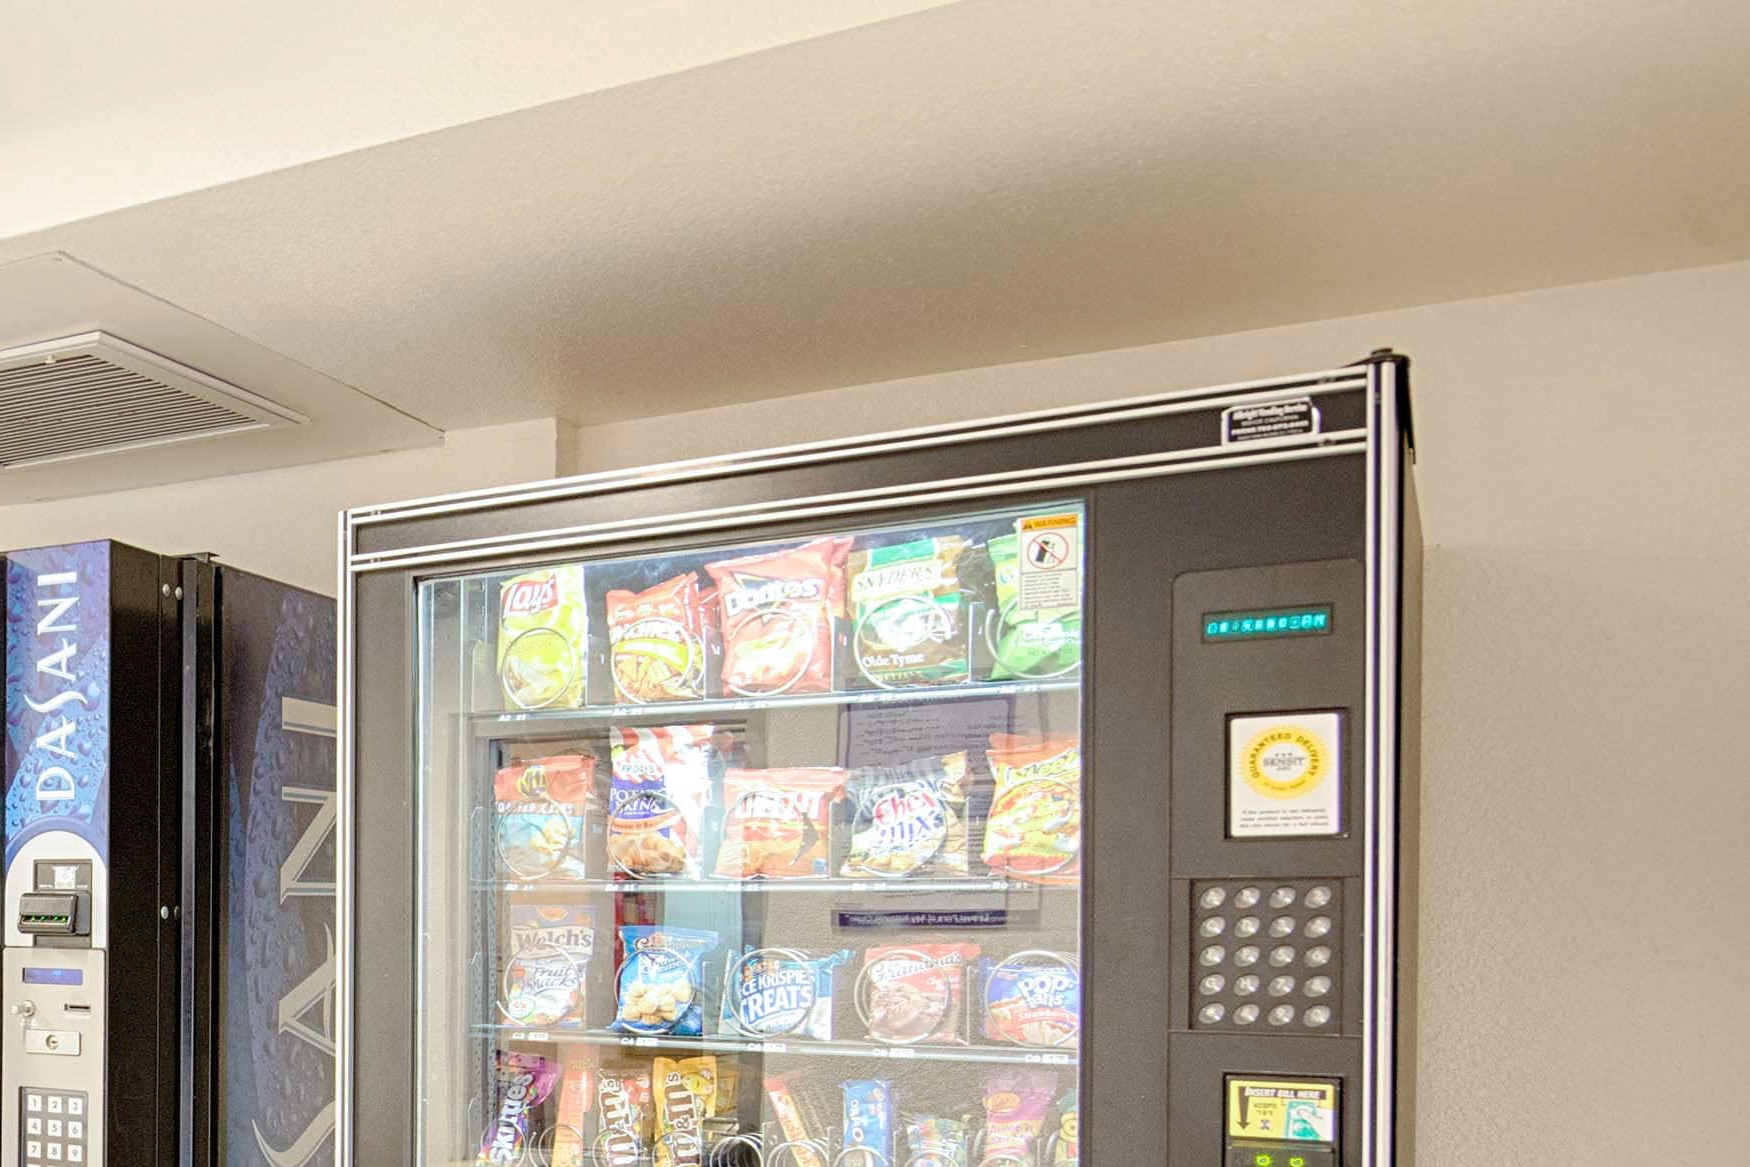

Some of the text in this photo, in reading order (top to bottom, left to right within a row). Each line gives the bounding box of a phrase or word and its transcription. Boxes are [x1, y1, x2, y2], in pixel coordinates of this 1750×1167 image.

[1034, 517, 1076, 528] WARNING
[862, 651, 925, 668] Olde Tyme
[24, 571, 88, 801] DASANI
[875, 791, 936, 823] Chex
[514, 926, 593, 950] Welch's
[758, 968, 816, 990] KRISPIES
[739, 984, 813, 1025] TREATS
[1244, 1086, 1323, 1099] INSERT BILL HERE
